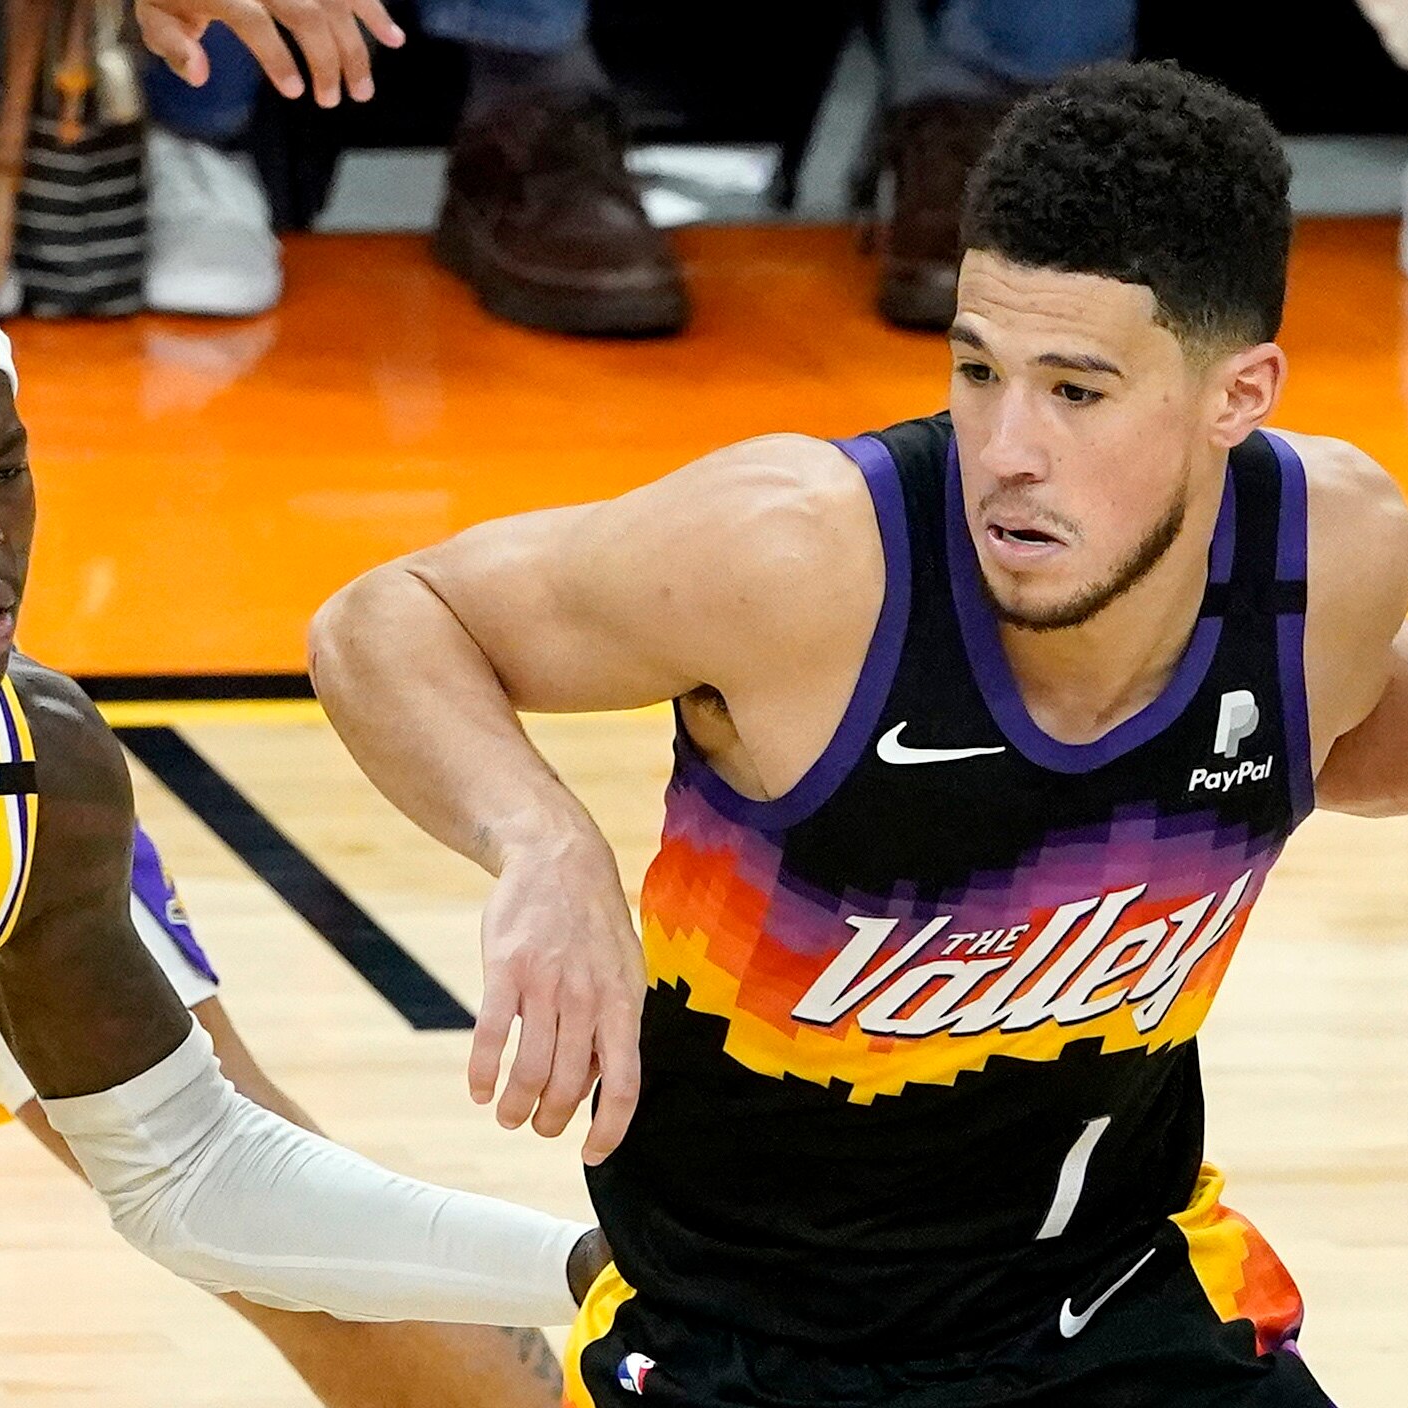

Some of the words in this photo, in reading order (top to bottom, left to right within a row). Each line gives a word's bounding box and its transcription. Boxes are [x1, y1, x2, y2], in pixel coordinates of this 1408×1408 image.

[1188, 755, 1273, 792] PayPal
[791, 868, 1253, 1036] Valley
[939, 923, 1031, 957] THE
[1033, 1115, 1112, 1241] 1
